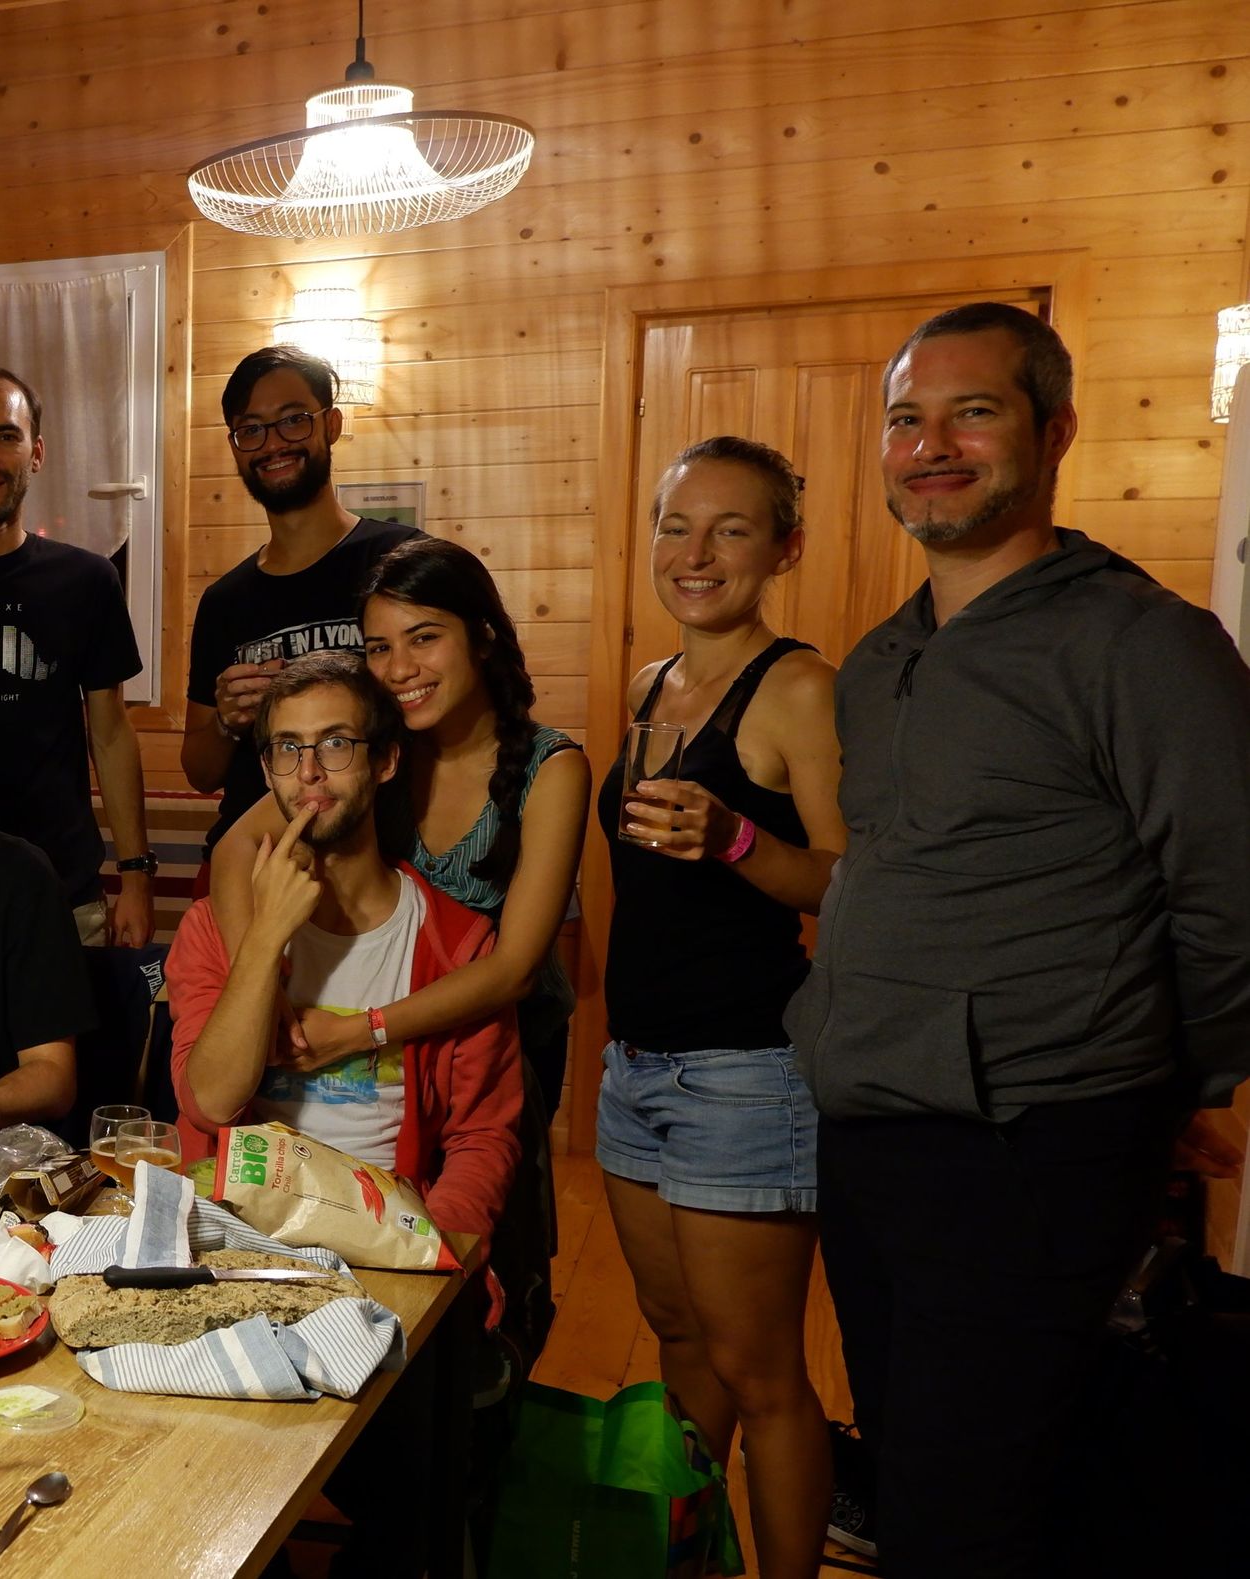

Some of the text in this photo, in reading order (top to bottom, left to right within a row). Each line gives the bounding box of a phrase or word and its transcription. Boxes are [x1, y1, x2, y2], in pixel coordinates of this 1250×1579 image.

[313, 624, 365, 650] LYON
[228, 1128, 245, 1184] Carrefour
[240, 1133, 270, 1187] BIO
[271, 1137, 286, 1190] Tortilla chips
[283, 1175, 292, 1194] Chili
